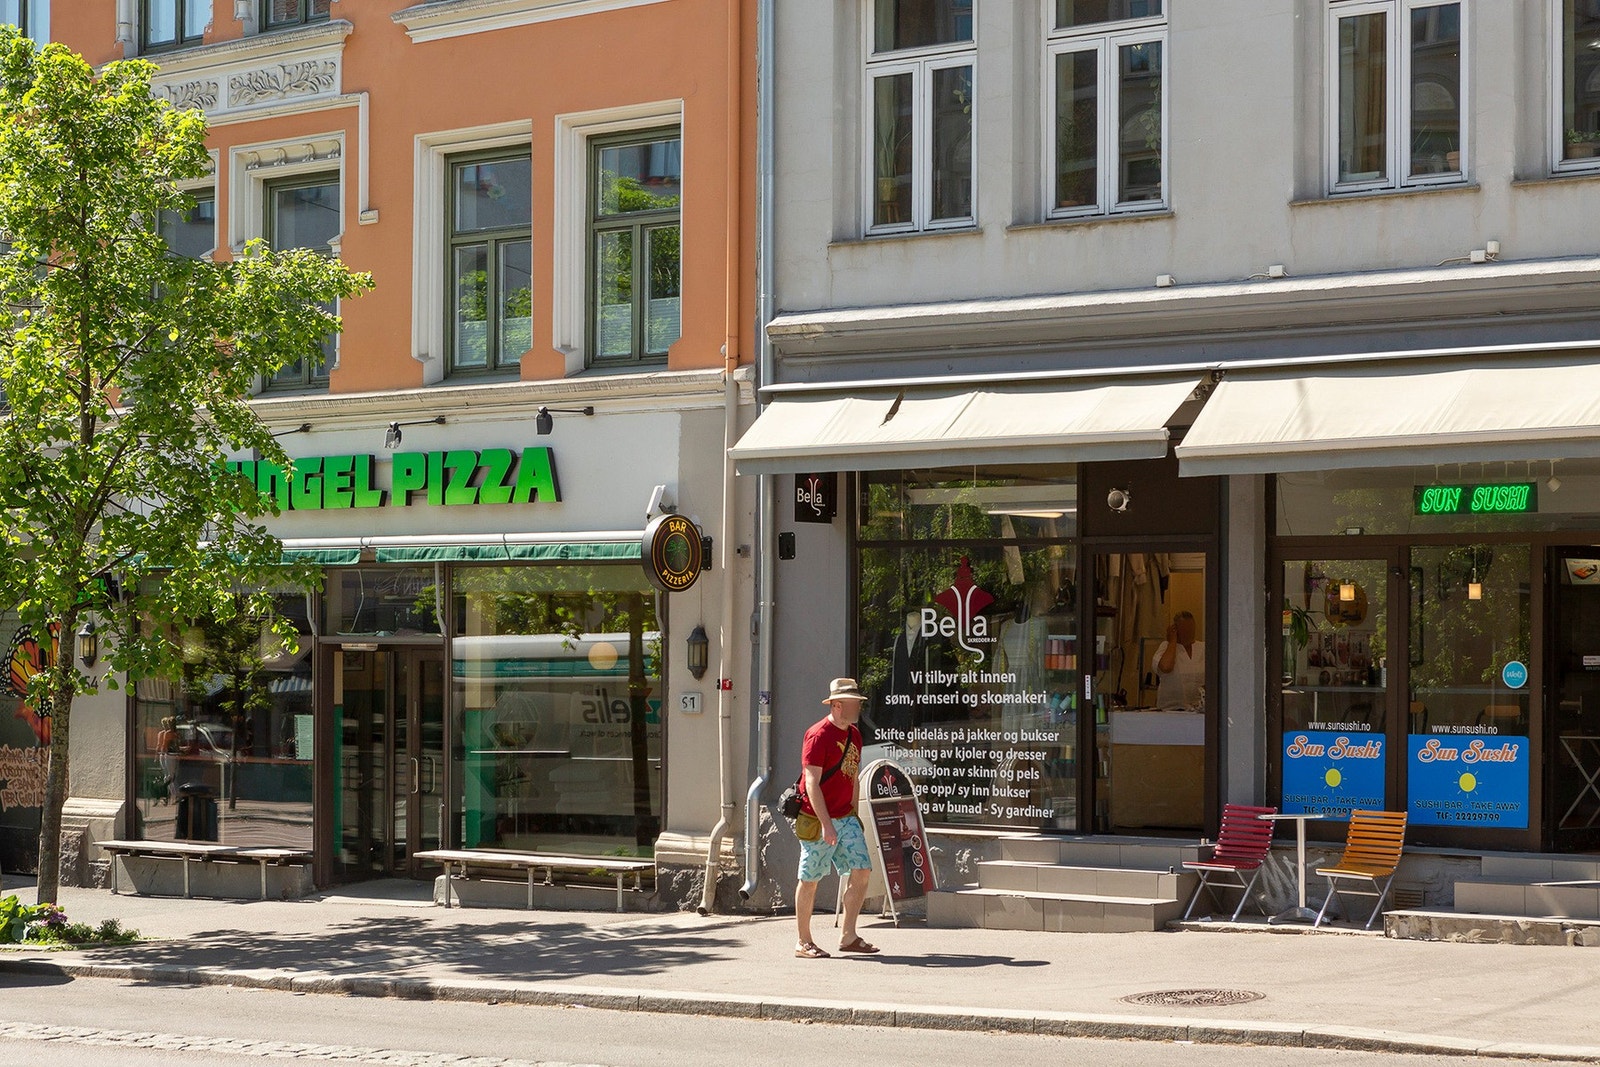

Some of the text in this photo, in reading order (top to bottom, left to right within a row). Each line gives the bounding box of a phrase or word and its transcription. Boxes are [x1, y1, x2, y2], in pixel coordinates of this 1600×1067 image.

[211, 447, 563, 512] NGEL PIZZA
[1421, 486, 1529, 512] SUN SUSHI
[669, 520, 687, 533] BAR
[662, 569, 694, 585] PIZZERIA
[910, 669, 1016, 686] Vi tilbyr alt innen
[885, 690, 1047, 707] søm, renseri og skomakeri
[1308, 720, 1371, 731] www.sunsushi.no
[1431, 723, 1498, 735] www.sunsushi.no
[874, 728, 1060, 743] Skifte glidelås på jakker og bukser
[883, 746, 1047, 762] Tilpasning av kjoler og dresser
[1286, 735, 1383, 760] Sun Sushi
[1418, 738, 1519, 764] Sun Sushi
[953, 768, 965, 778] av
[967, 765, 997, 778] skinn
[1000, 769, 1014, 781] og
[1016, 767, 1040, 781] pels
[930, 784, 956, 797] opp/
[958, 786, 970, 797] sy
[972, 785, 989, 796] inn
[992, 785, 1030, 798] bukser
[1284, 794, 1309, 803] SUSHI
[1311, 795, 1328, 804] BAR
[1336, 796, 1357, 805] TAKE
[1359, 798, 1382, 806] AWAY
[1416, 800, 1441, 809] SUSHI
[1444, 801, 1463, 809] BAR
[1470, 802, 1493, 810] TAKE
[1495, 802, 1520, 811] AWAY
[932, 803, 946, 813] av
[947, 801, 982, 815] bunad
[991, 803, 1003, 818] Sy
[1006, 804, 1055, 819] gardiner
[1455, 812, 1500, 821] 22229799
